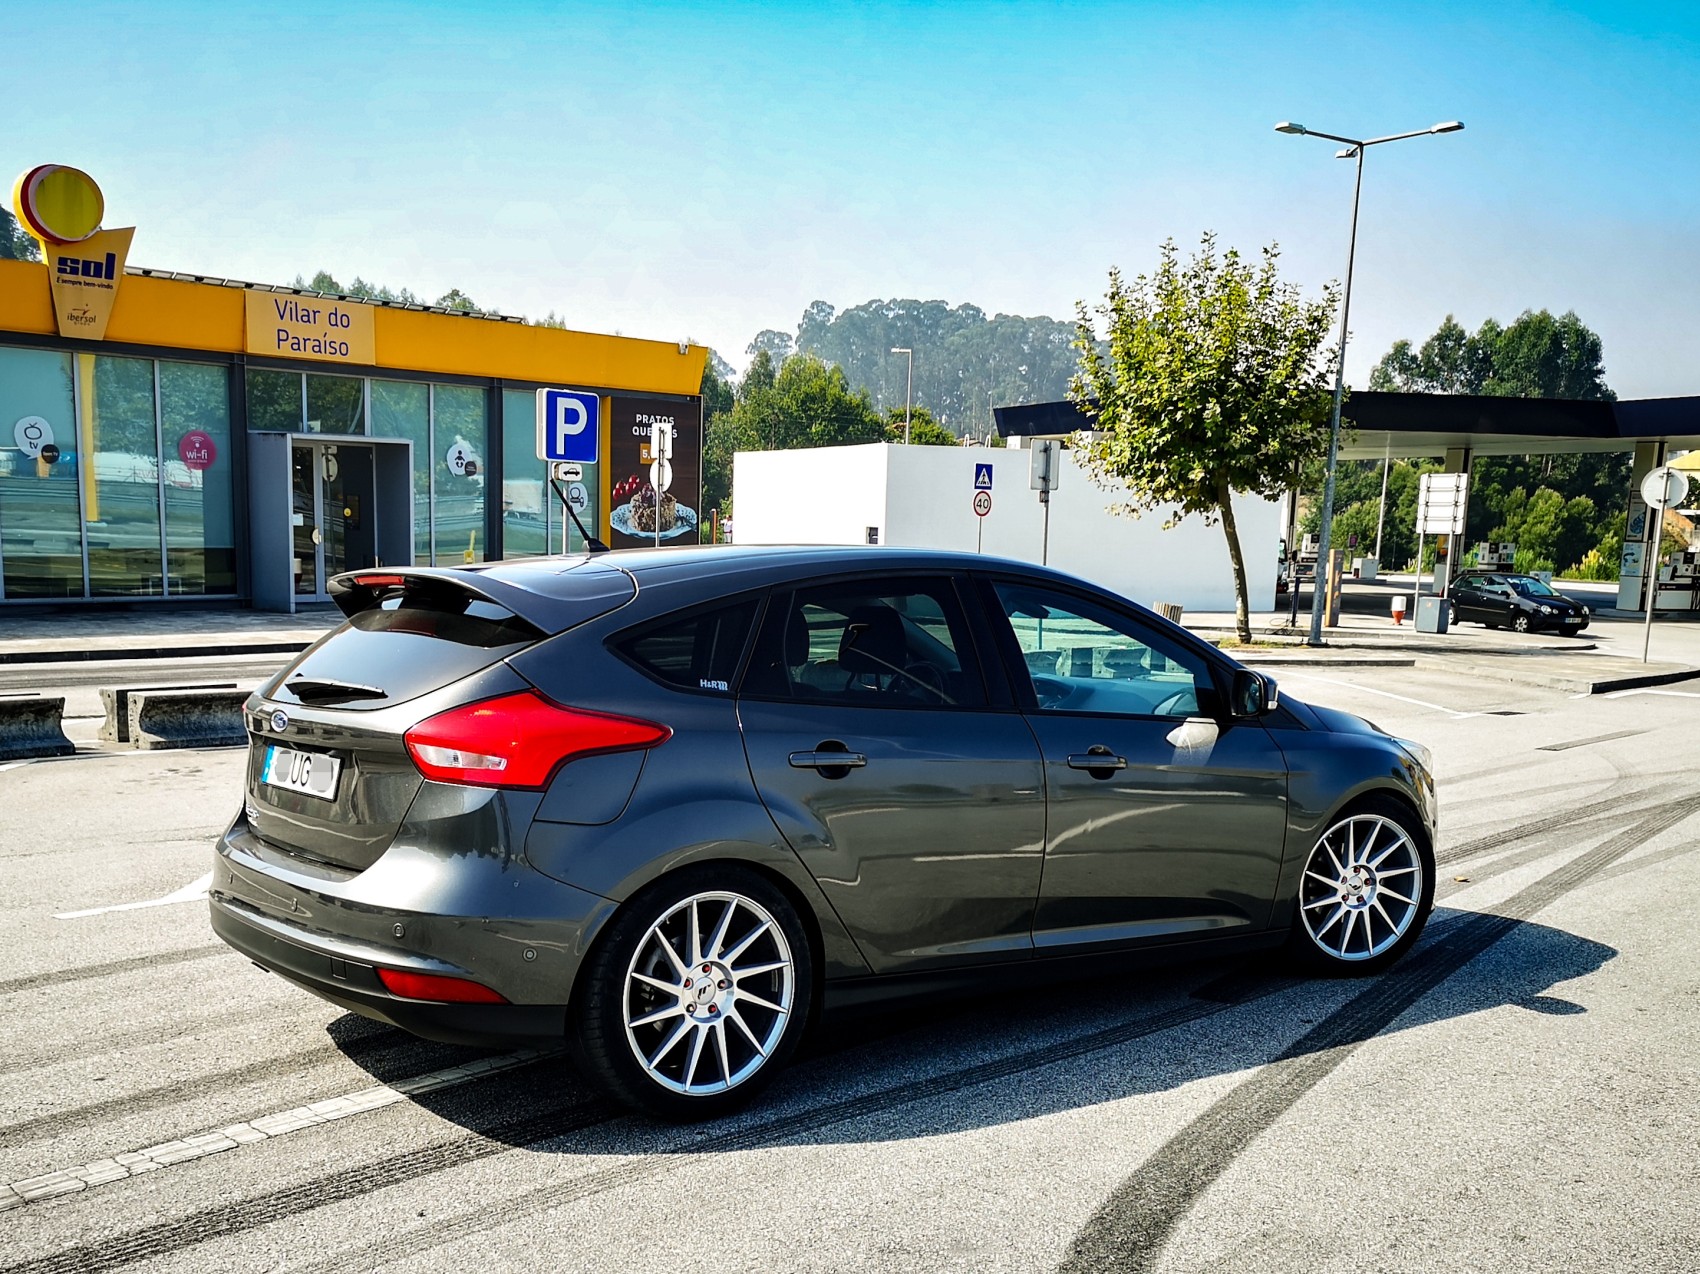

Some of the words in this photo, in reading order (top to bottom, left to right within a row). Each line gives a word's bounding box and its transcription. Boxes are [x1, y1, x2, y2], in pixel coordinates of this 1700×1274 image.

[57, 252, 116, 280] sol
[61, 278, 83, 287] sempre
[83, 280, 114, 290] bem-vindo
[66, 312, 97, 323] ibersol
[274, 298, 321, 325] Vilar
[328, 306, 351, 328] do
[276, 328, 350, 357] Paraíso
[635, 413, 675, 426] PRATOS
[556, 396, 588, 456] P
[29, 440, 39, 450] tv
[185, 449, 208, 460] wi-fi
[976, 498, 989, 509] 40
